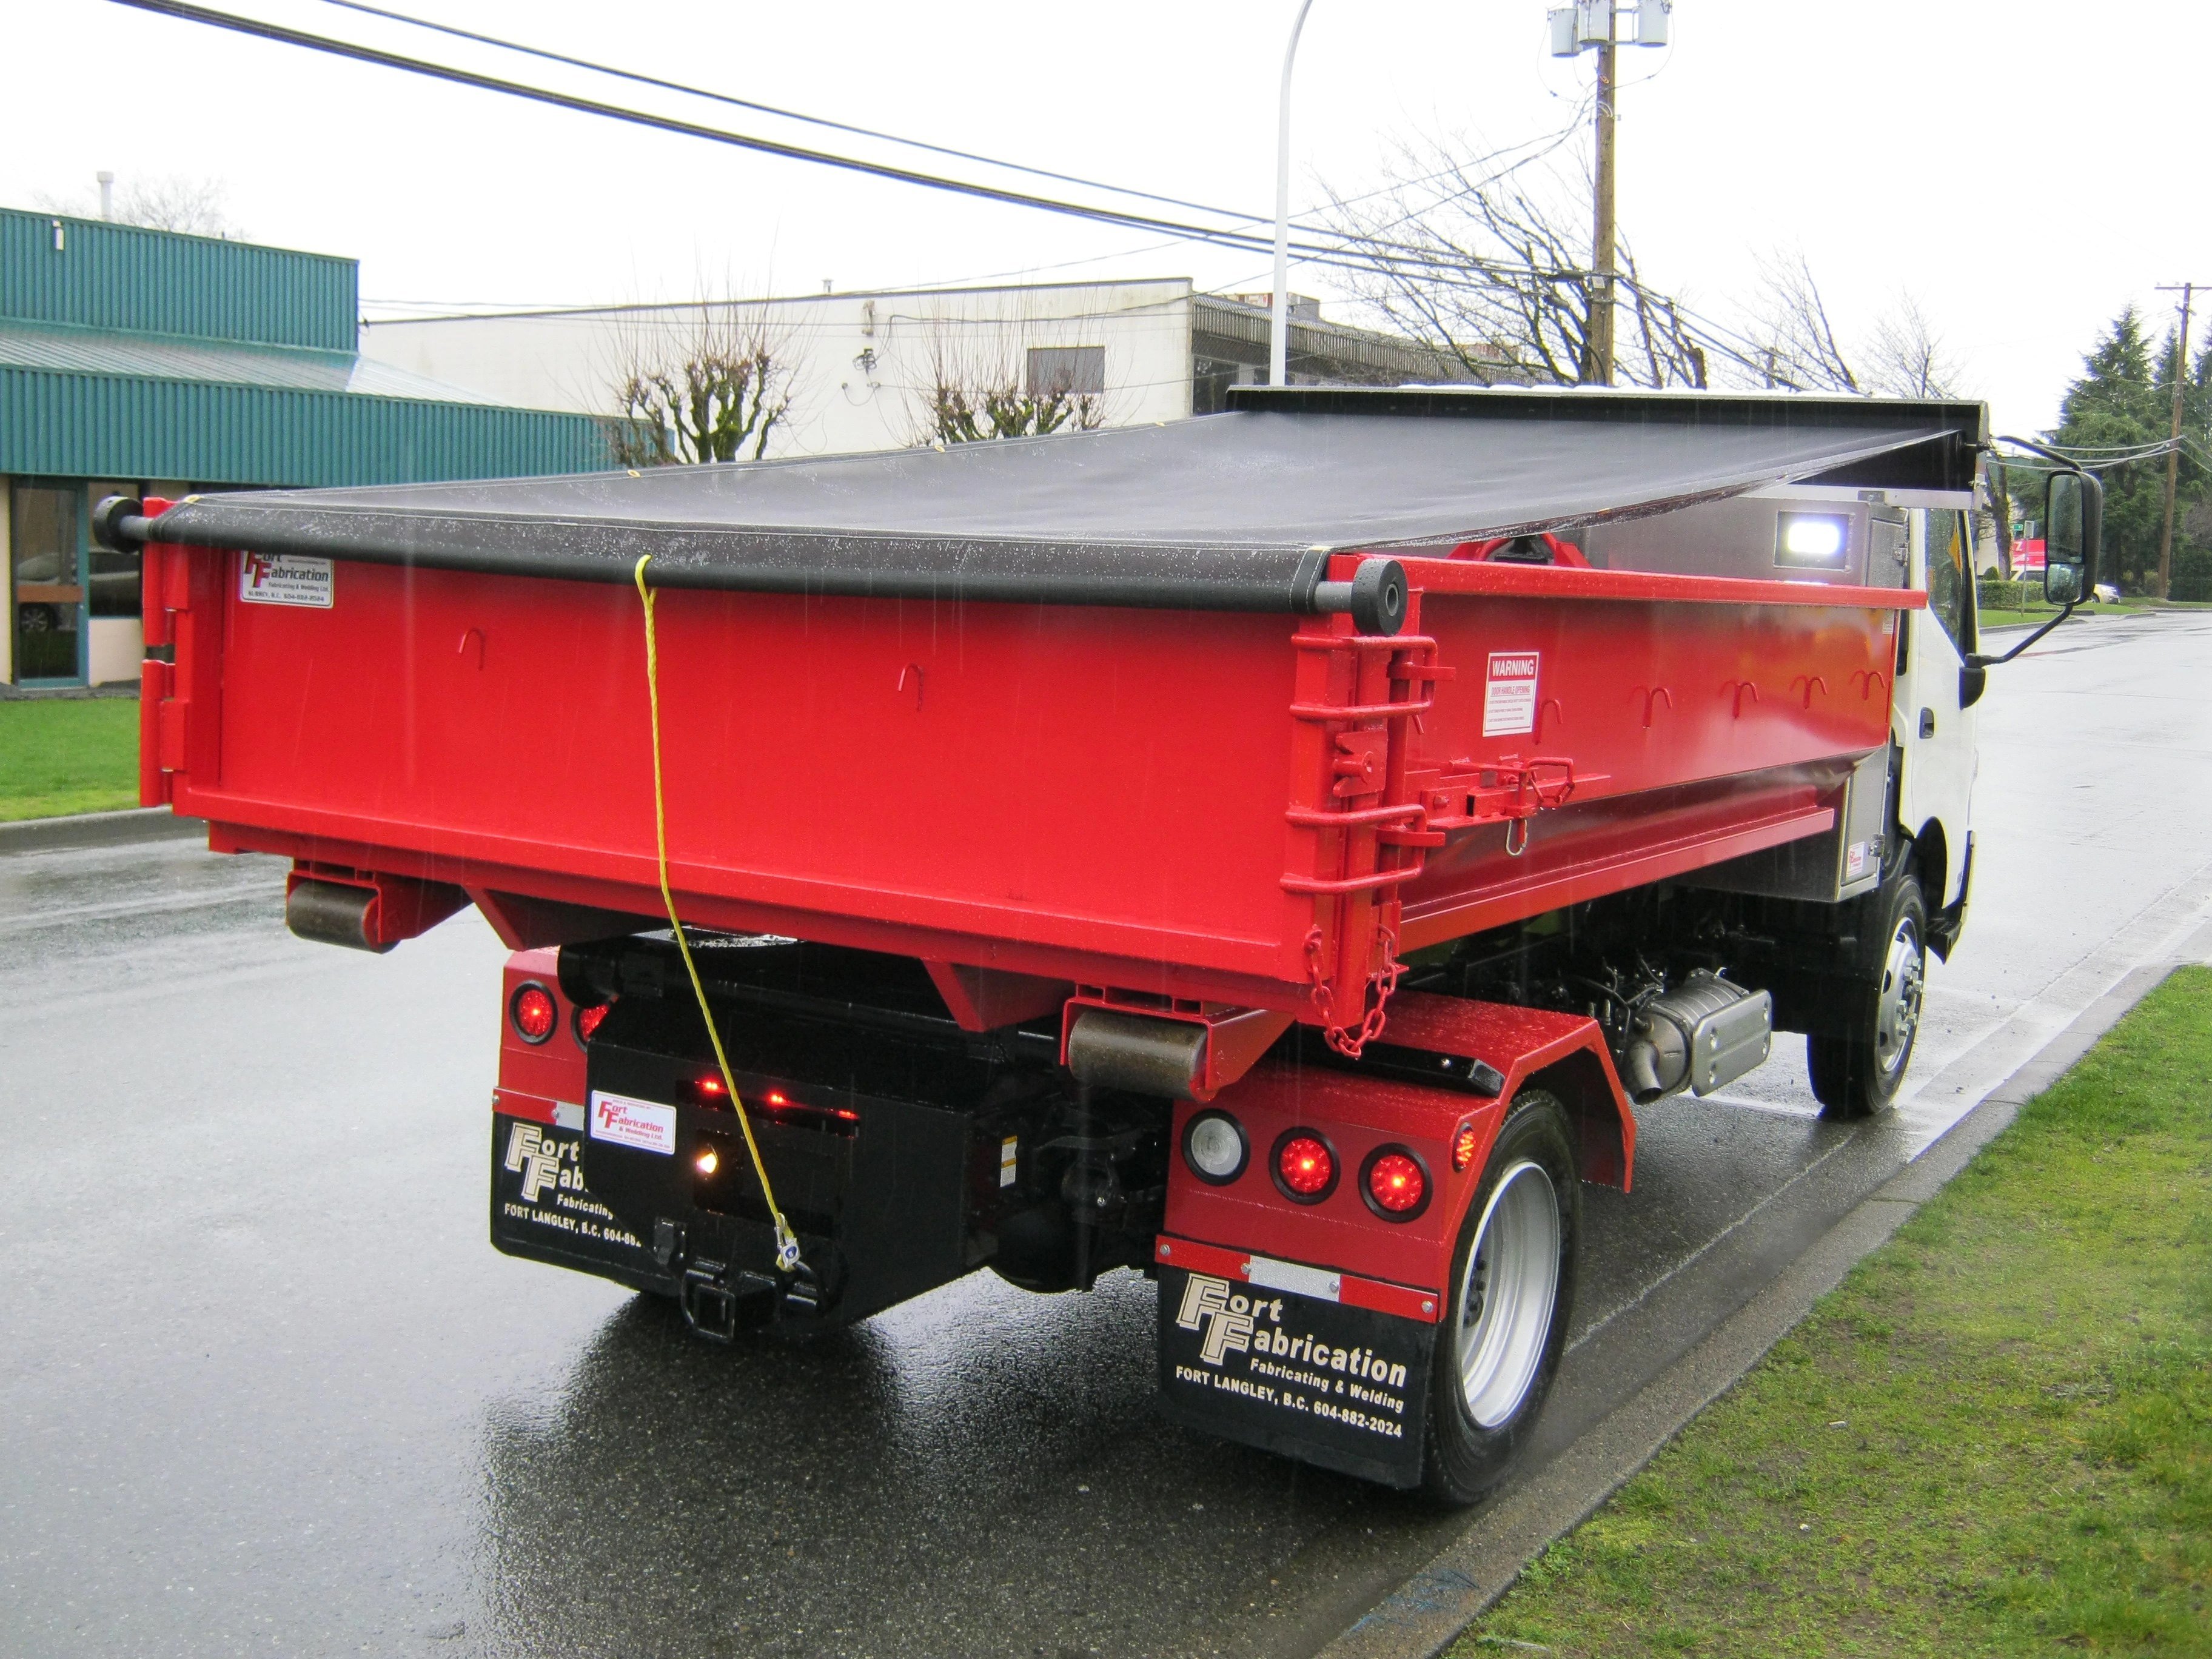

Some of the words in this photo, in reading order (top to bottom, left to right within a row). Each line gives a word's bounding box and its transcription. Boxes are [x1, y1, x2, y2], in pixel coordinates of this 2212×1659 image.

[253, 561, 329, 588] Fabrication
[1492, 659, 1534, 677] WARNING
[598, 1101, 628, 1118] Fort
[605, 1111, 664, 1133] Fabrication
[504, 1122, 580, 1173] Fort
[625, 1128, 650, 1138] Welding
[504, 1202, 529, 1219] FORT
[532, 1209, 578, 1234] LANGLEY,
[581, 1221, 601, 1238] B.C.
[1175, 1273, 1283, 1330] Fort
[1200, 1310, 1407, 1388] Fabrication
[1175, 1365, 1210, 1386] FORT
[1214, 1373, 1279, 1406] LANGLEY,
[1283, 1392, 1309, 1412] B.C.
[1313, 1401, 1403, 1438] 604-882-2024
[1250, 1358, 1330, 1392] Fabricating
[1335, 1379, 1344, 1394] &
[1350, 1383, 1404, 1413] Welding
